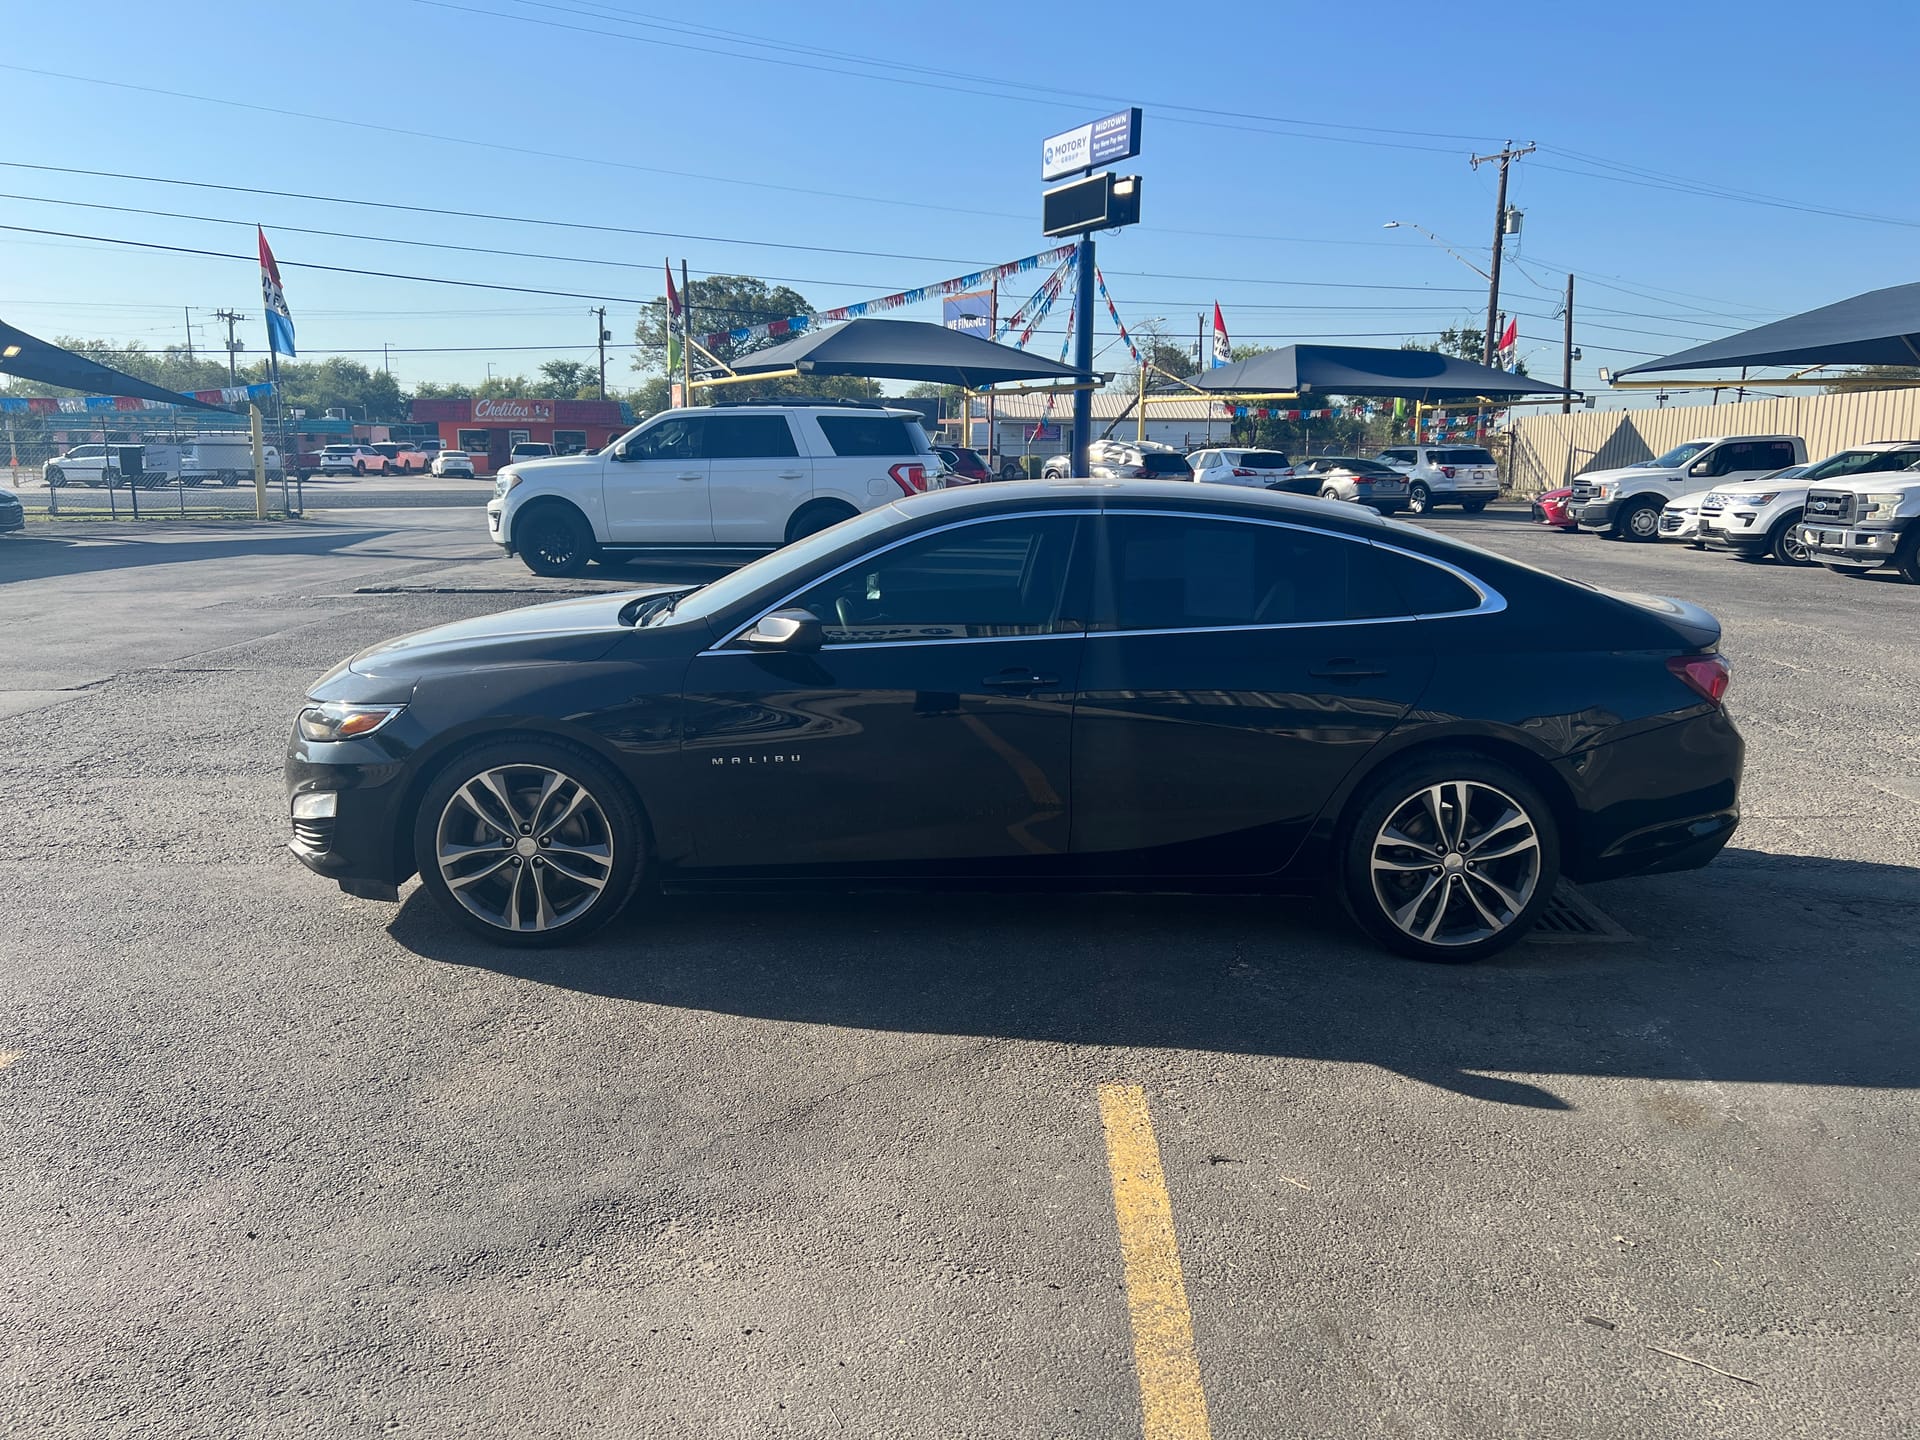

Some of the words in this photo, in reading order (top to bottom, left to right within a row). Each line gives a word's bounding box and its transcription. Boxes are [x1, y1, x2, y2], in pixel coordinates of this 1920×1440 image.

[1095, 114, 1127, 133] MIDTOWN
[1055, 136, 1087, 157] MOTORY
[947, 319, 957, 330] WE
[958, 316, 987, 329] FINANCE
[475, 399, 529, 416] Chelitas
[711, 754, 801, 766] MALIBU
